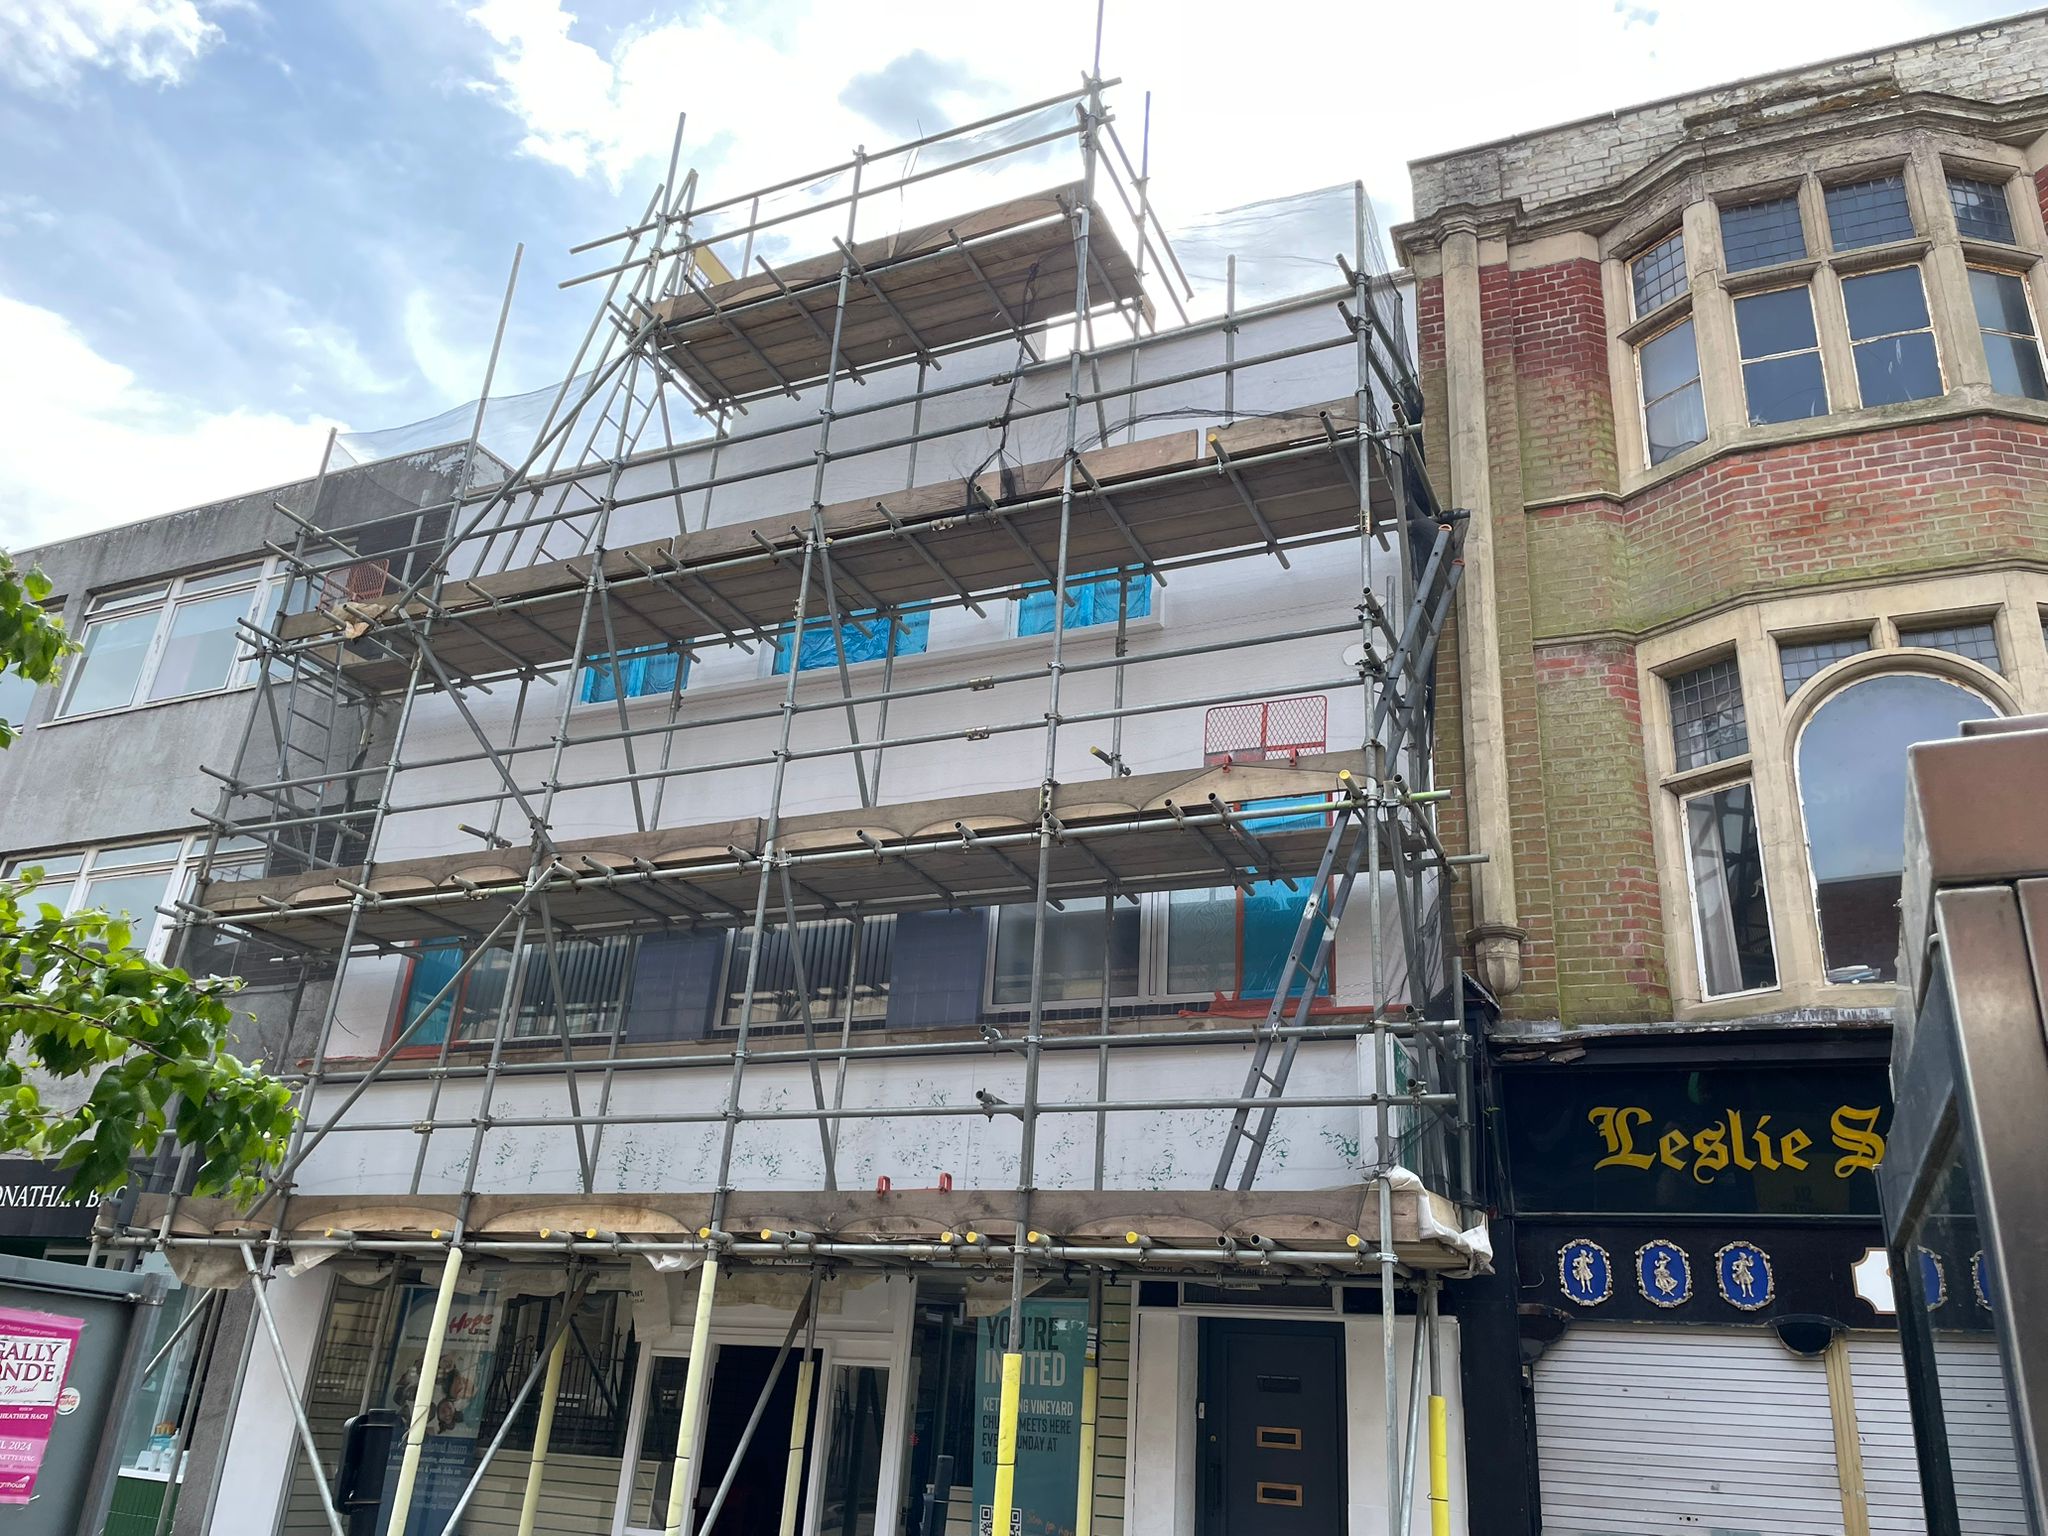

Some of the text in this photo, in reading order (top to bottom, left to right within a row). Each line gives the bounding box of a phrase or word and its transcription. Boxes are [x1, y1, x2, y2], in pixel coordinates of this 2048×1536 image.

[1588, 1104, 1885, 1184] Leslie S
[449, 1312, 494, 1334] Hope
[0, 1361, 56, 1382] NDE
[984, 1349, 1066, 1387] INITED
[1030, 1399, 1074, 1417] VINEYARD
[1019, 1416, 1048, 1433] MEETS
[1049, 1419, 1072, 1435] HERE
[8, 1441, 32, 1451] 2024
[1017, 1434, 1045, 1452] UNDAY
[1047, 1437, 1058, 1453] AT
